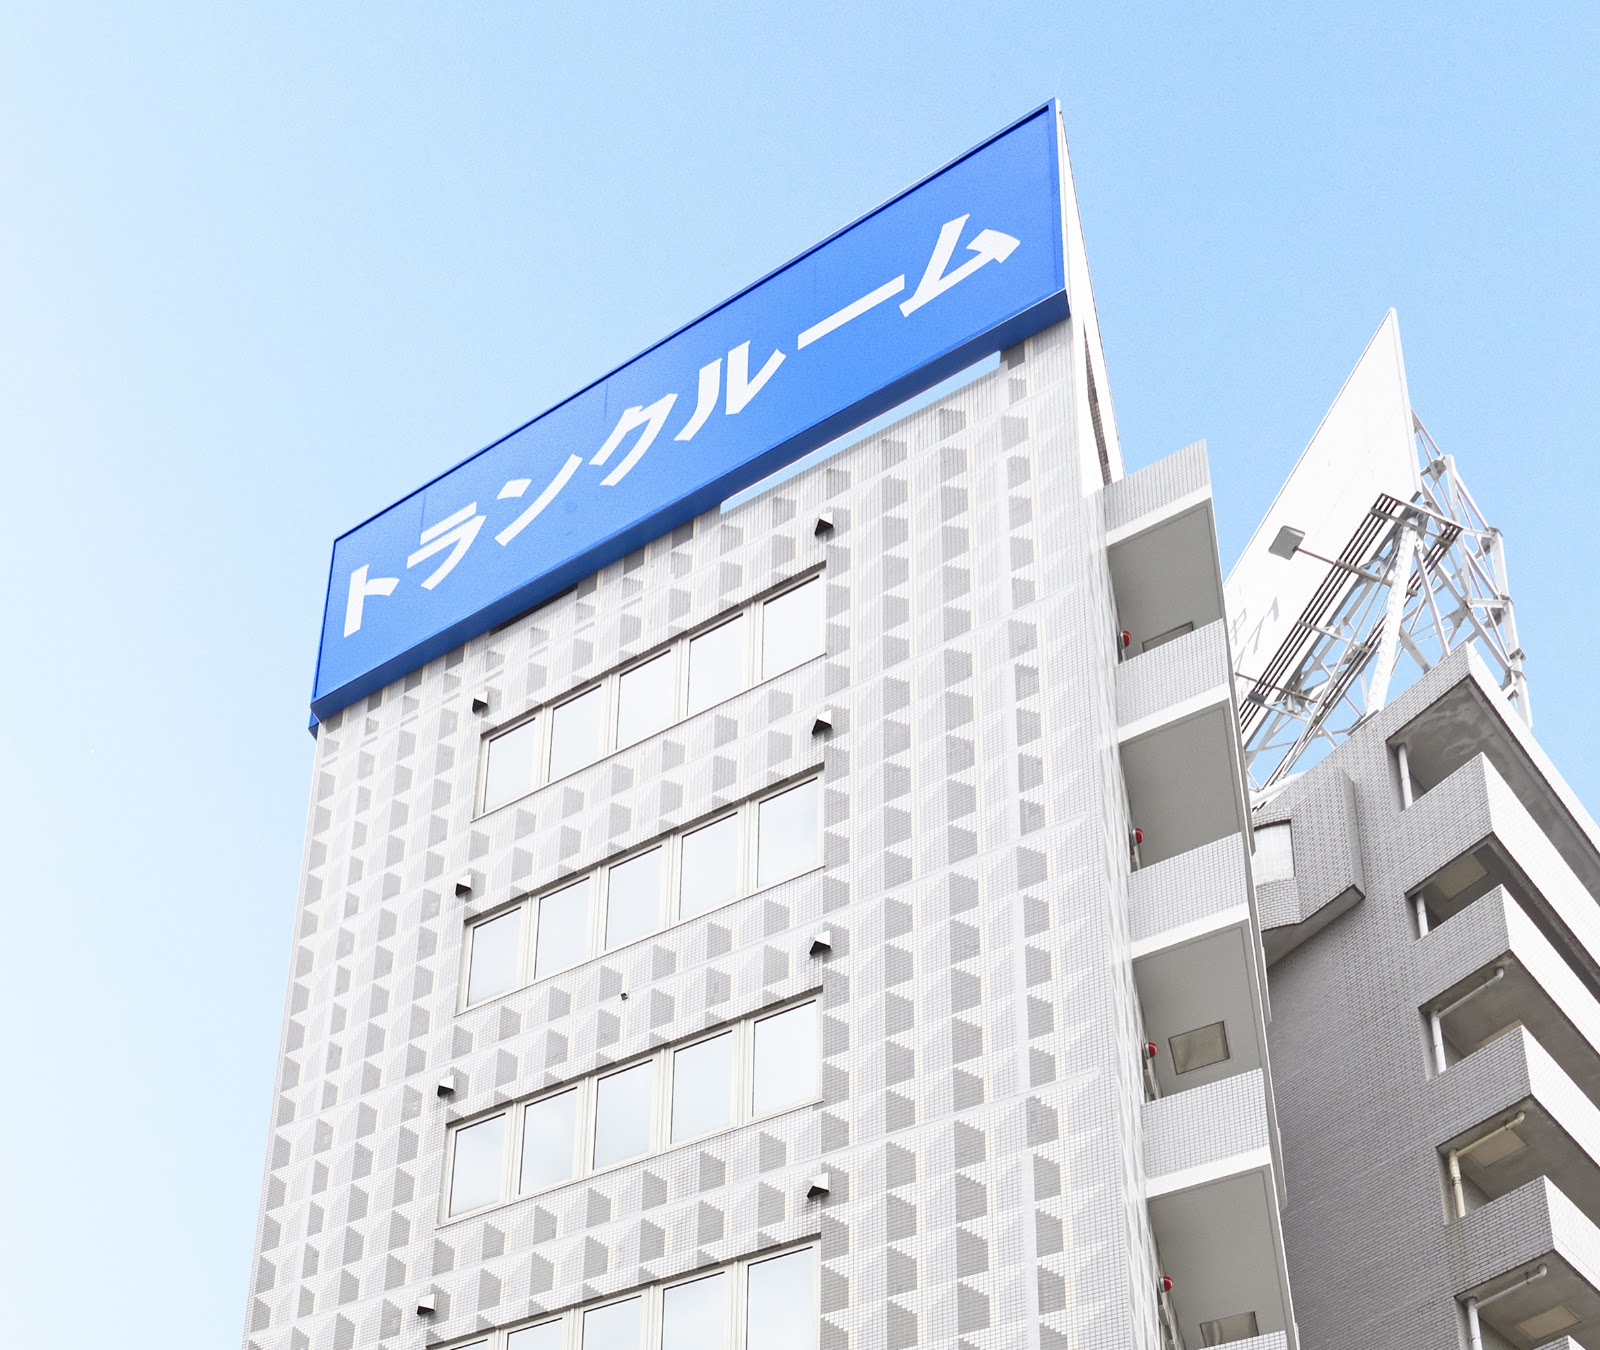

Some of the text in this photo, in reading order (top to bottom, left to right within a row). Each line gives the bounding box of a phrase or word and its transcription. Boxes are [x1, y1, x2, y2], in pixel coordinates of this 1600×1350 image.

[343, 212, 1021, 638] トランクルーム
